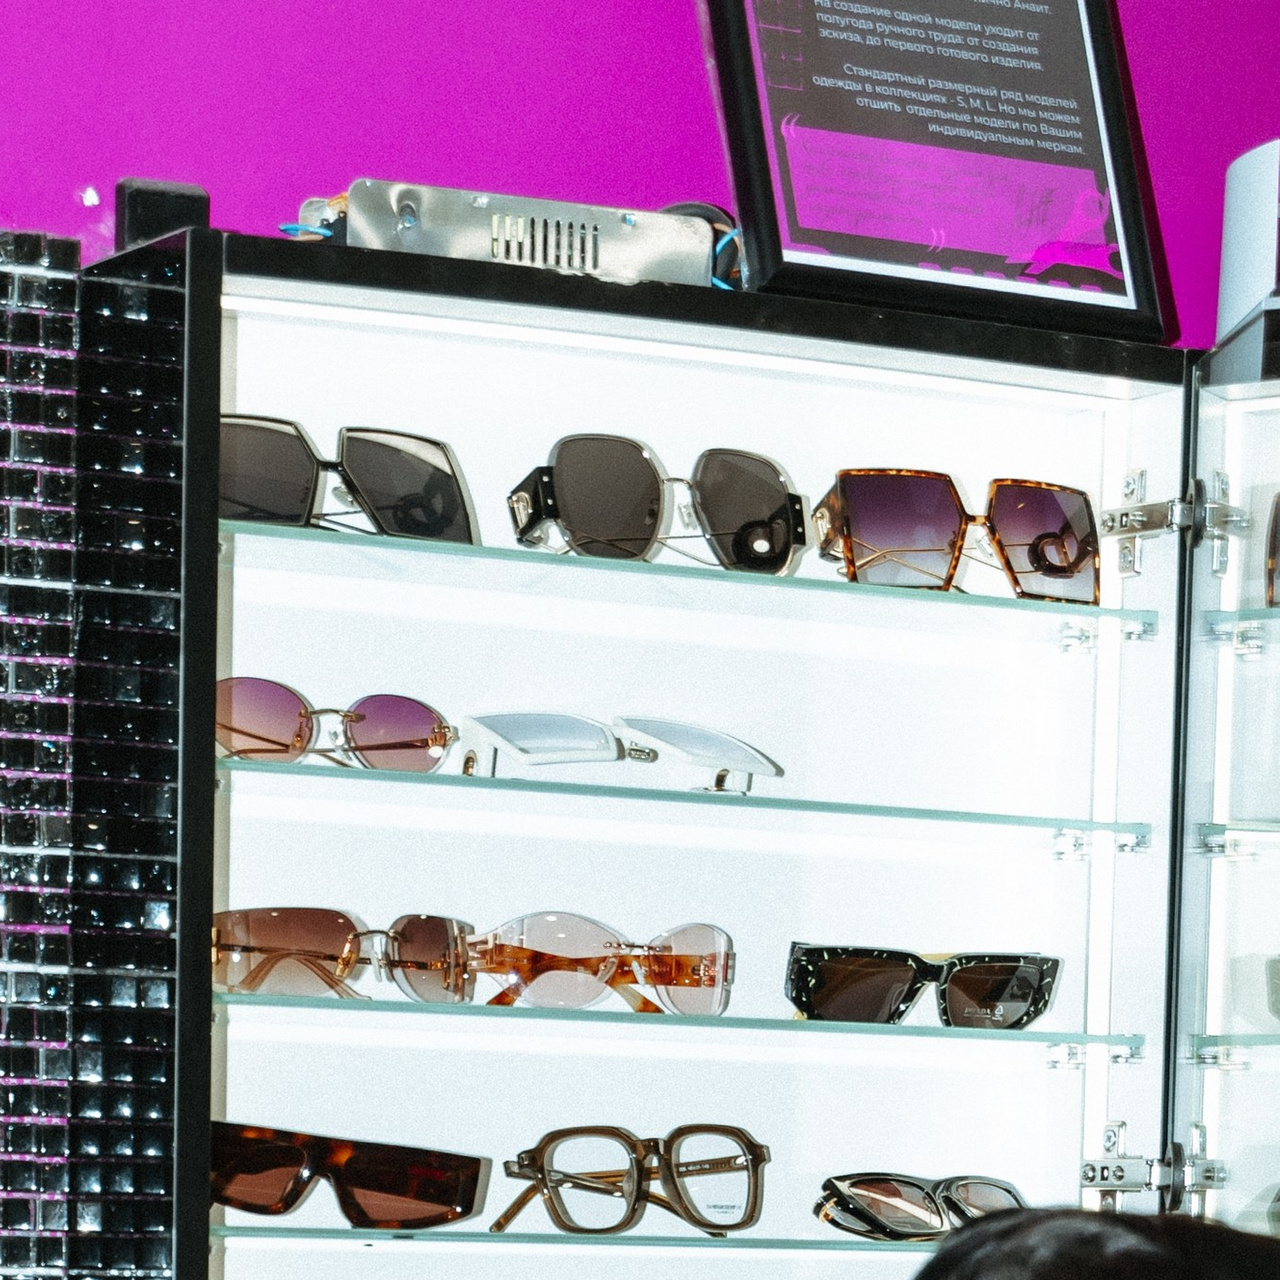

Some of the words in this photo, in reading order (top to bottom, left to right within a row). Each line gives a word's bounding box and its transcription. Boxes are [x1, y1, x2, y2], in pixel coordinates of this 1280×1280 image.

[833, 1, 892, 17] создание
[894, 11, 933, 24] одной
[935, 18, 982, 32] модели
[984, 25, 1024, 38] уходит
[1026, 32, 1040, 41] от
[974, 0, 1011, 8] ично
[816, 12, 874, 30] полугода
[876, 22, 926, 39] ручного
[928, 30, 965, 44] труда:
[966, 37, 980, 46] от
[982, 39, 1039, 56] создания
[865, 36, 881, 46] до
[883, 39, 934, 55] первого
[936, 46, 989, 63] готового
[991, 54, 1045, 72] изделия.
[812, 76, 862, 91] одежды
[865, 83, 873, 93] в
[875, 85, 948, 104] коллекциях
[998, 102, 1016, 115] Но
[1018, 107, 1037, 119] мы
[1039, 111, 1081, 125] можем
[843, 63, 926, 86] Стандартный
[928, 78, 998, 98] размерный
[1000, 89, 1023, 101] ряд
[1025, 93, 1078, 110] моделей
[856, 97, 902, 113] отшить
[906, 104, 972, 123] отдельные
[973, 115, 1020, 131] модели
[1022, 122, 1038, 133] по
[1040, 123, 1083, 140] Вашим
[928, 122, 1035, 147] индивидуальным
[1037, 140, 1086, 156] меркам.
